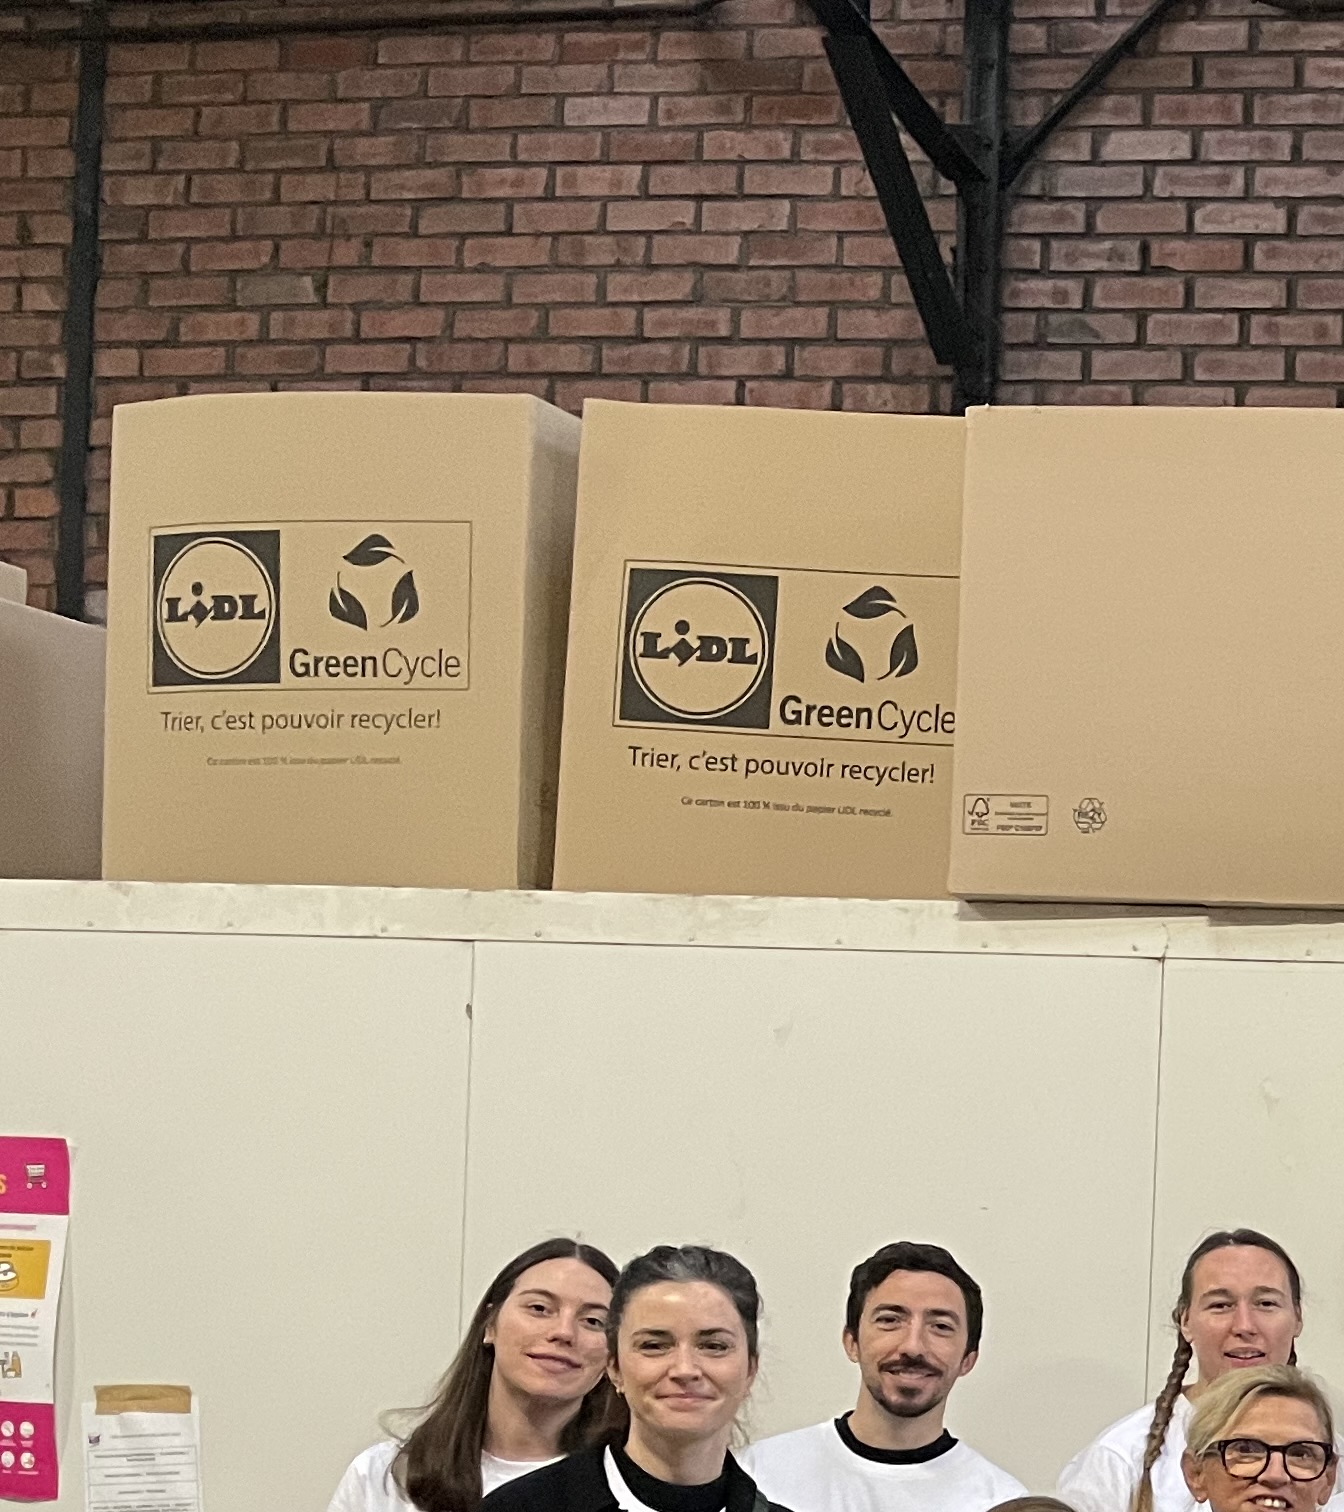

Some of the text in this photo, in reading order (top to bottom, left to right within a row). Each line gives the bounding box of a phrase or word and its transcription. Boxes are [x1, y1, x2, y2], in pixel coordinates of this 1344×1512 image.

[160, 707, 441, 735] Trier, c'est pouvoir recycler!
[628, 746, 935, 784] Trier, c'est pouvoir recycler!
